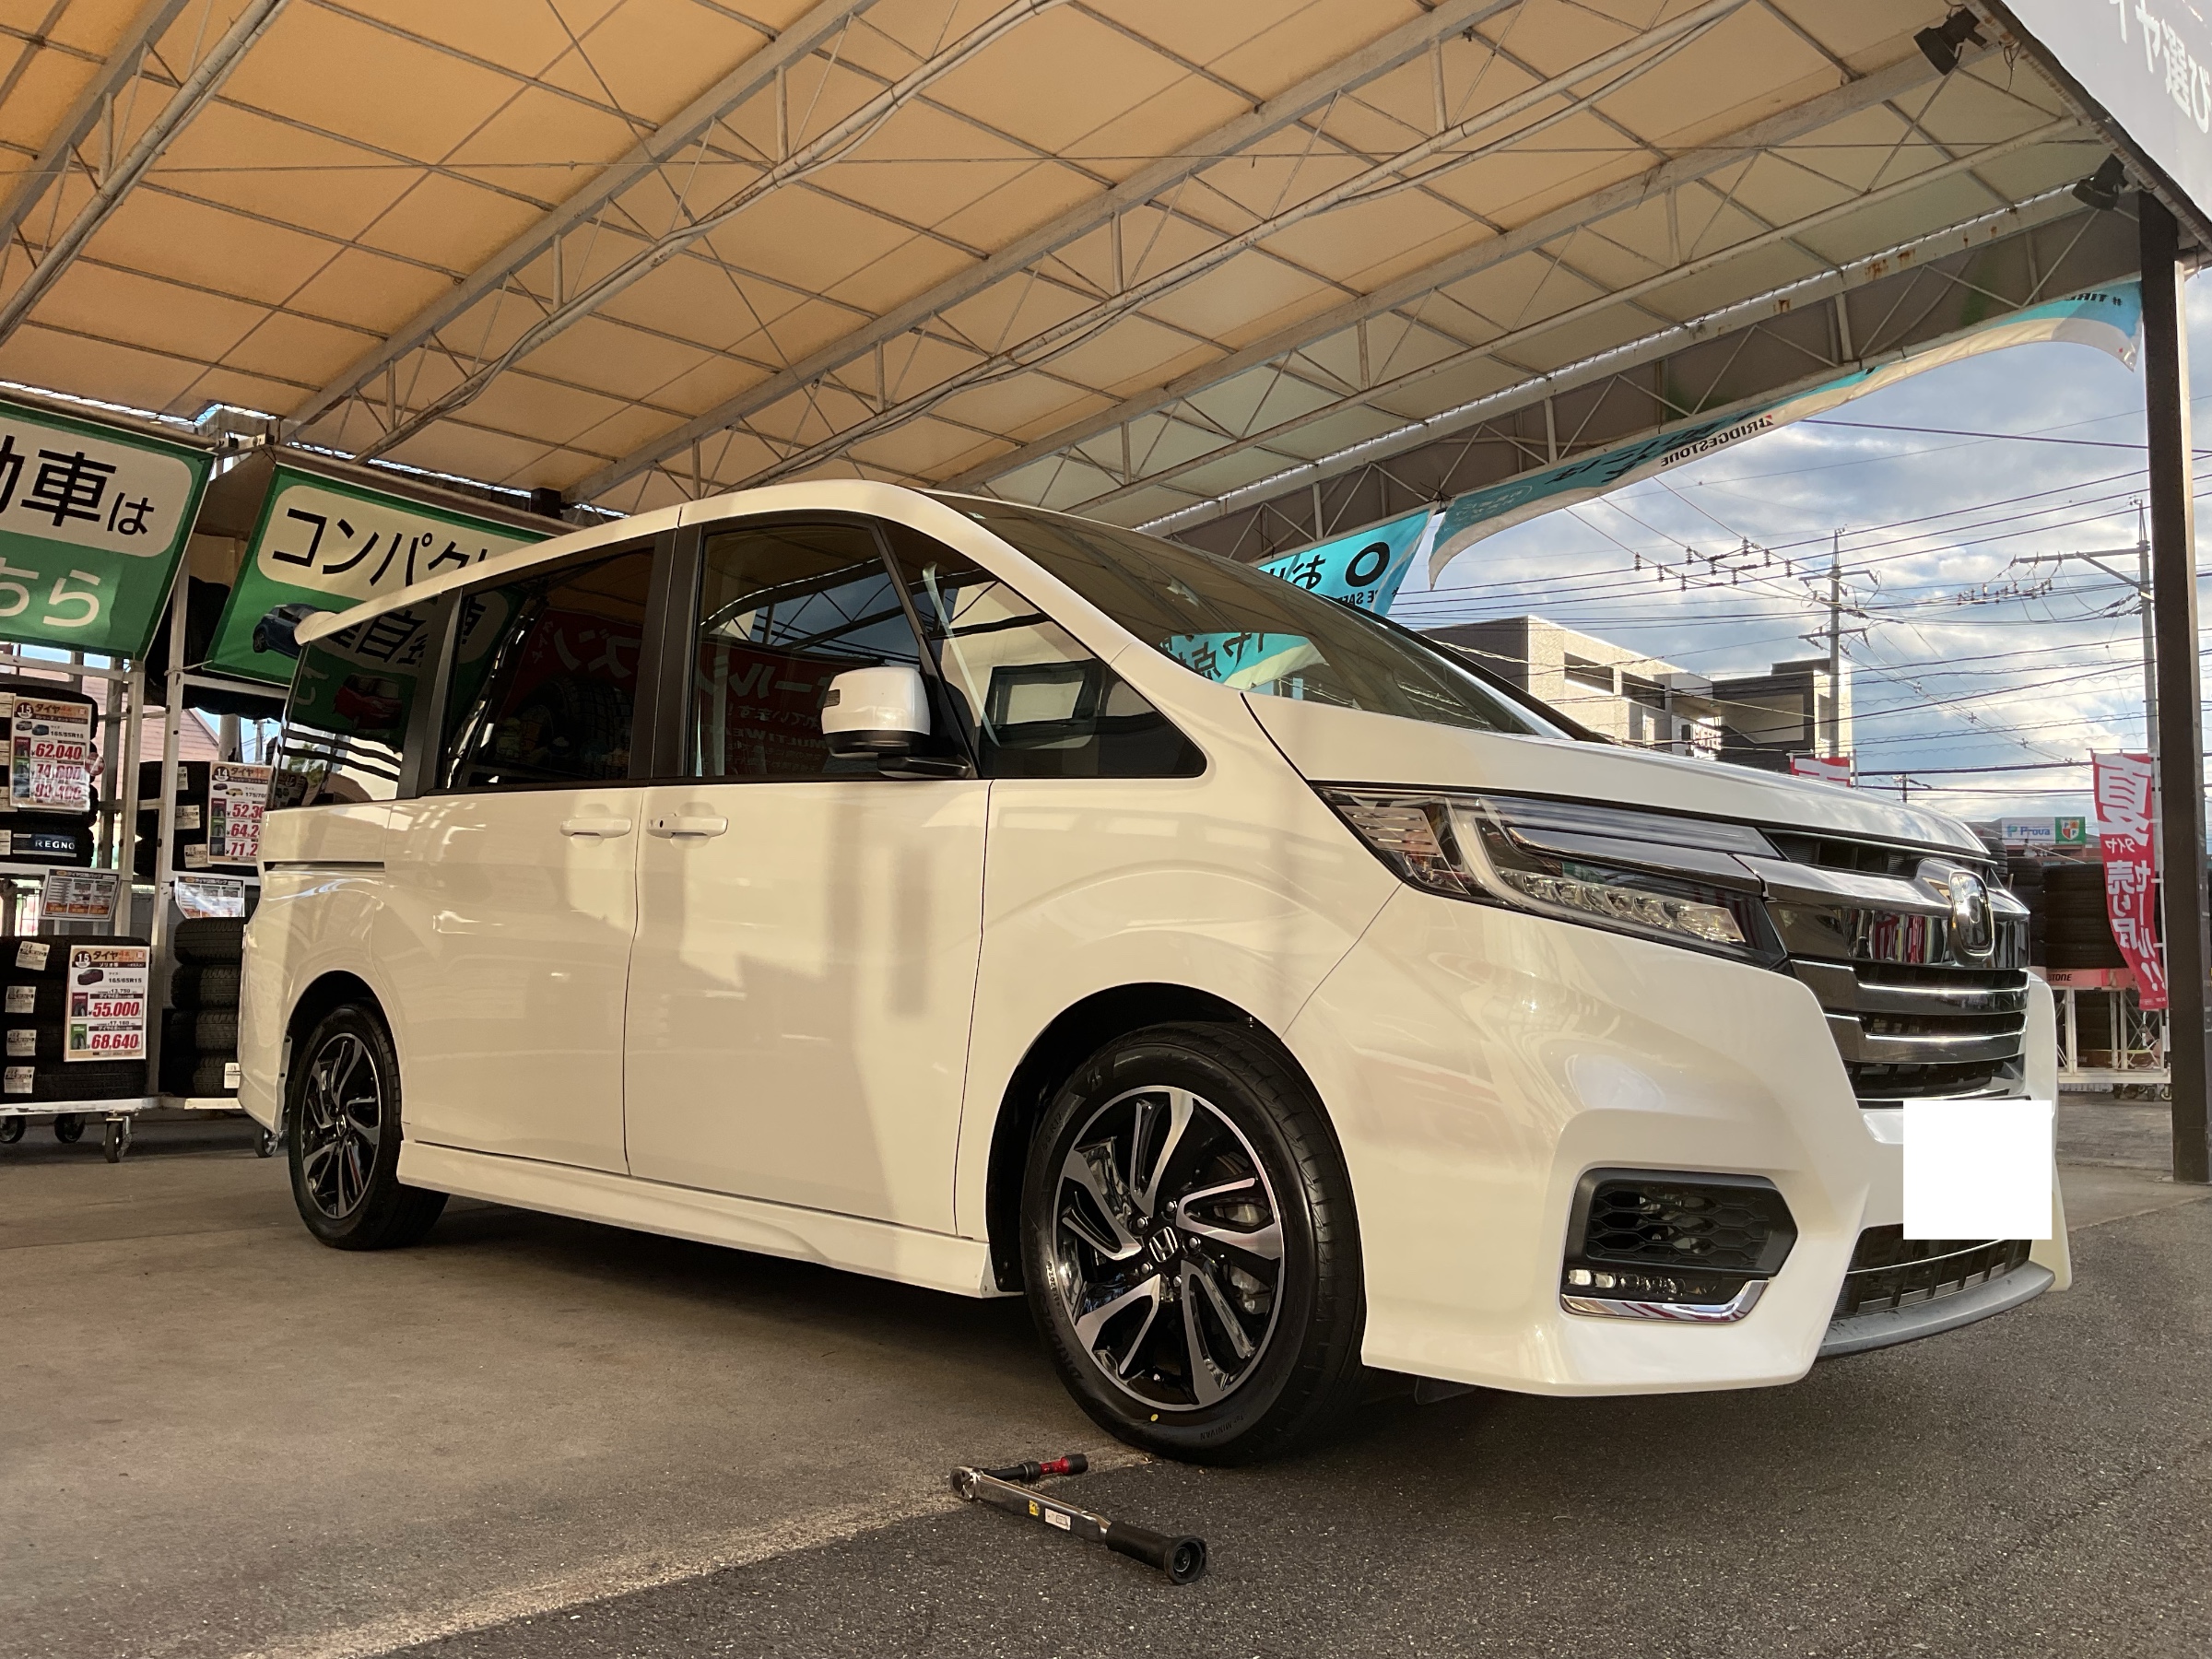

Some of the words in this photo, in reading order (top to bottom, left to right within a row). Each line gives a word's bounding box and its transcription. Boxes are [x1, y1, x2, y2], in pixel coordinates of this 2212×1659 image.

[272, 507, 488, 587] コンパク
[35, 703, 61, 714] タイヤ
[230, 767, 254, 777] タイヤ
[34, 839, 76, 850] REGNO
[93, 950, 119, 960] タイヤ
